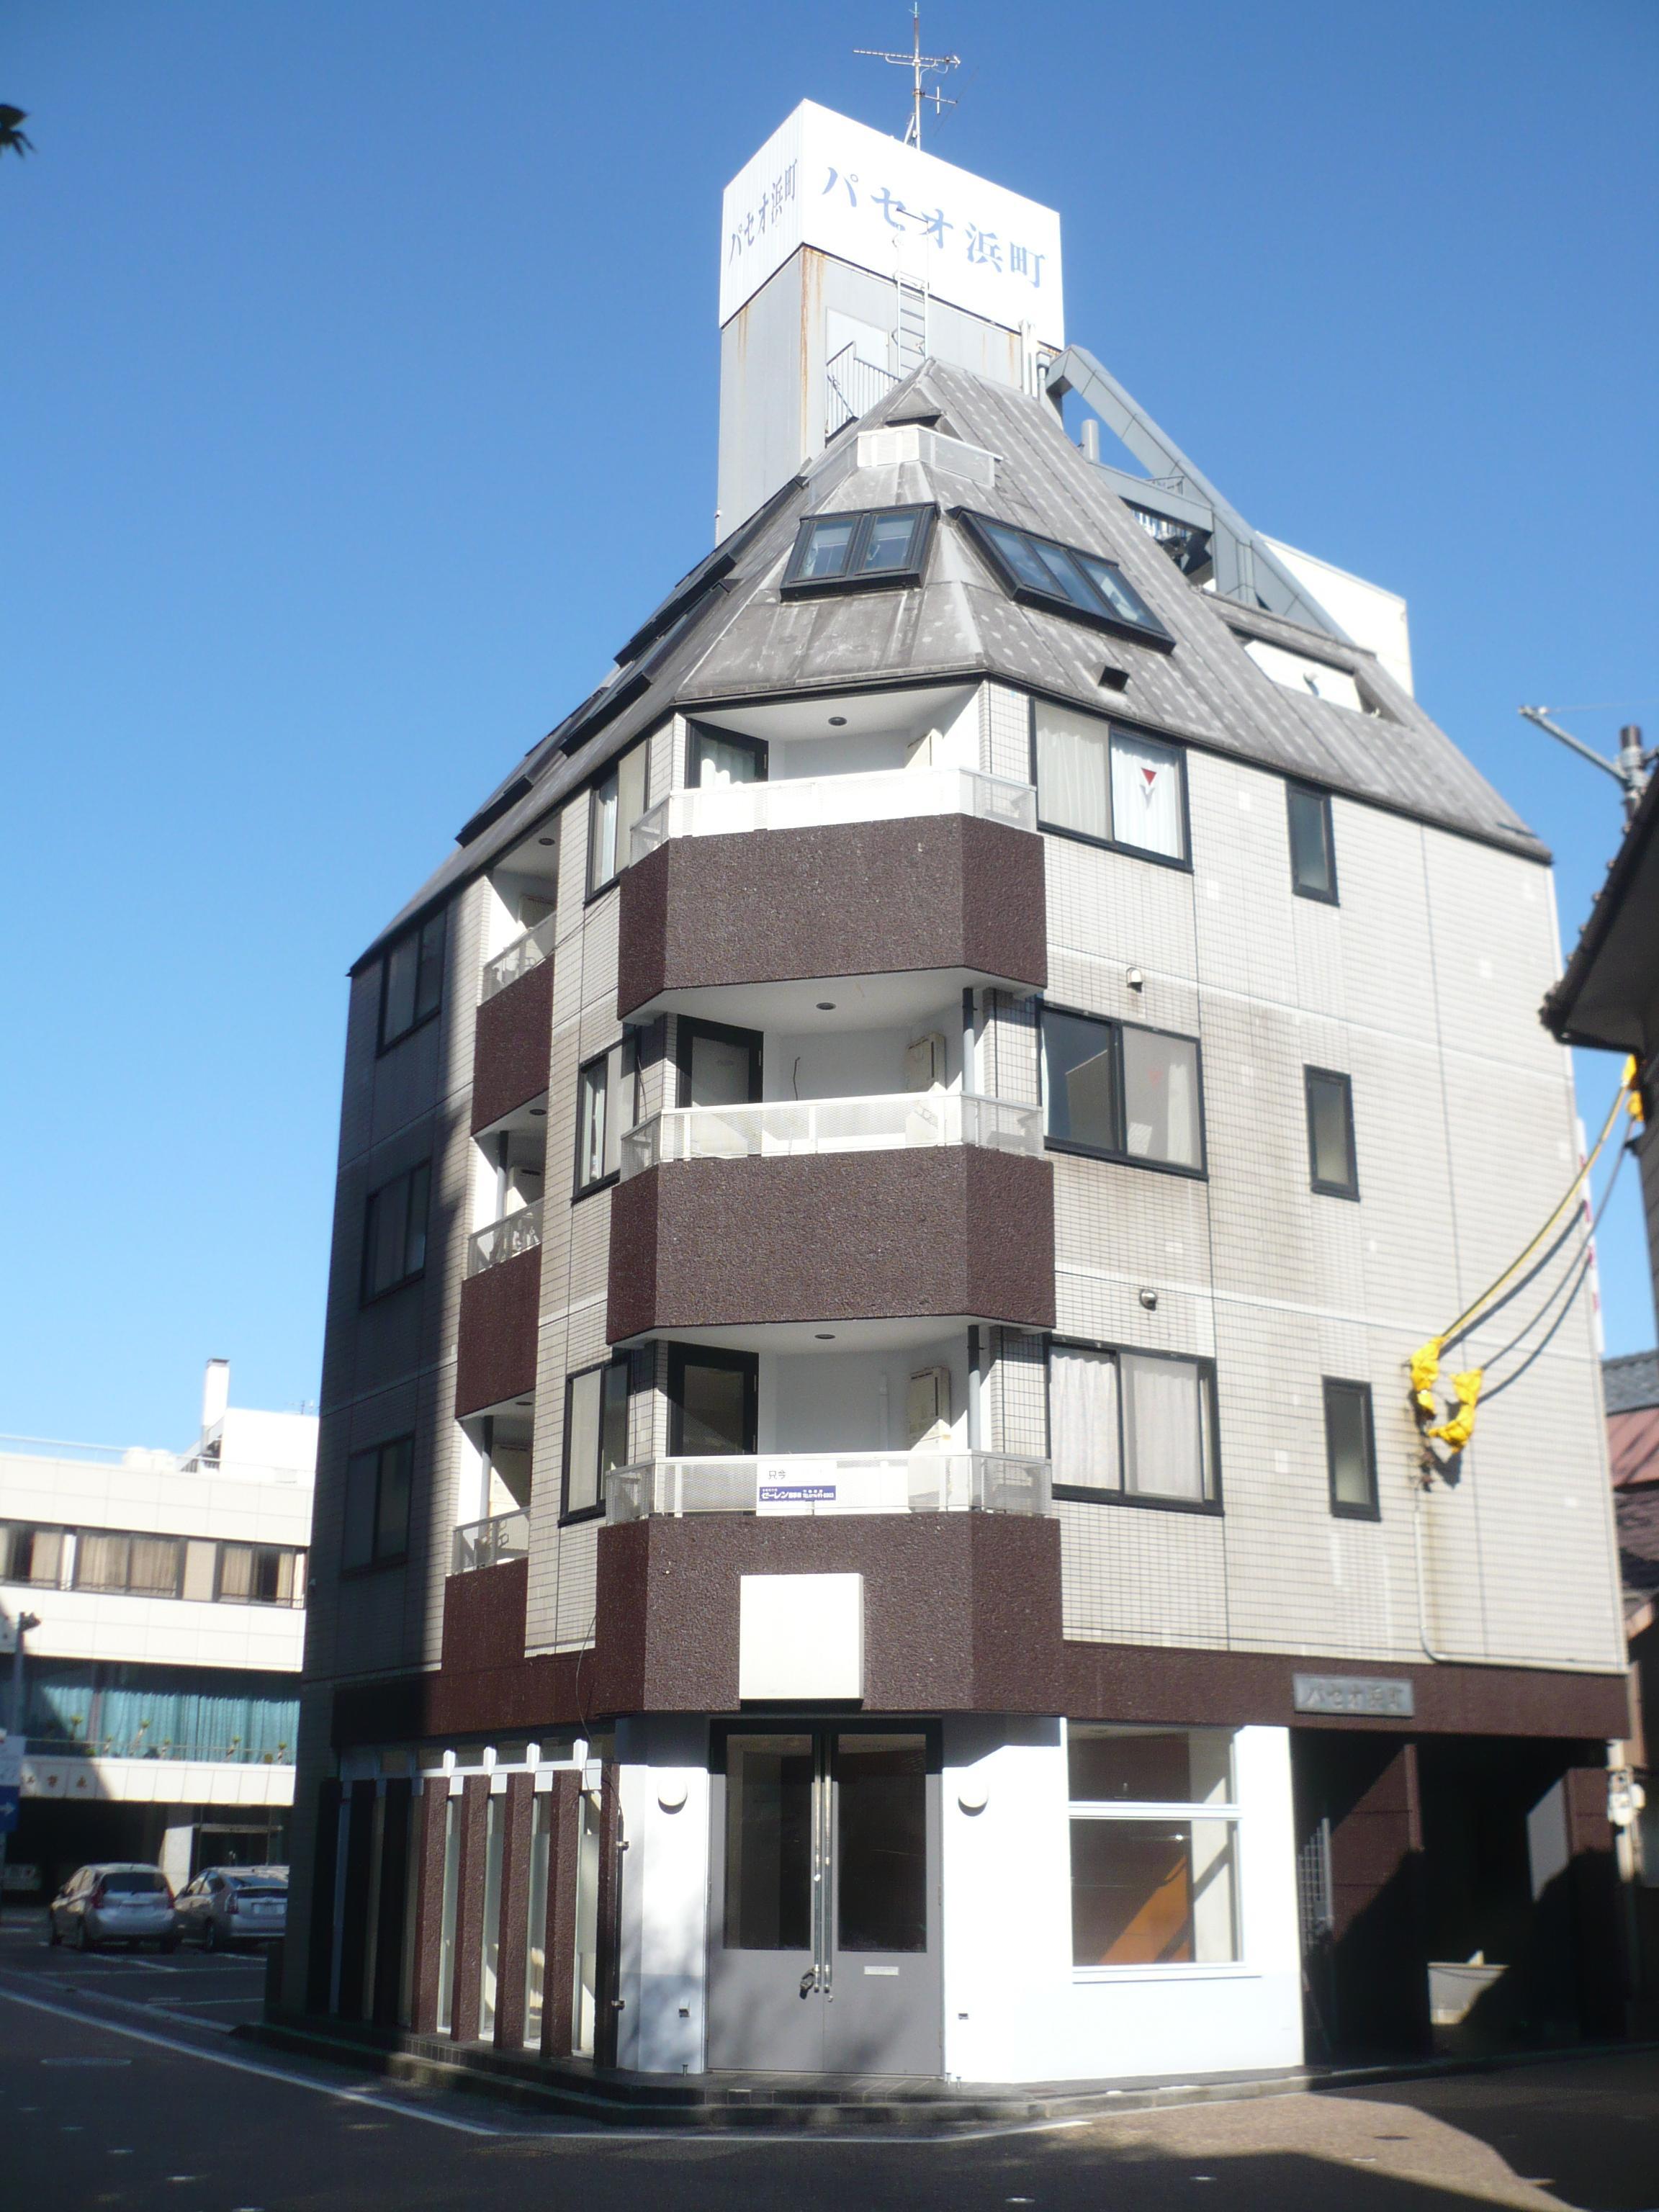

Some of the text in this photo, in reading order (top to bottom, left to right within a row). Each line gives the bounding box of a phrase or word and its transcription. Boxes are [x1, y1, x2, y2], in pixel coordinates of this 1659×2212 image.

[731, 159, 797, 264] パセオ浜町
[822, 166, 1046, 288] パセオ浜町
